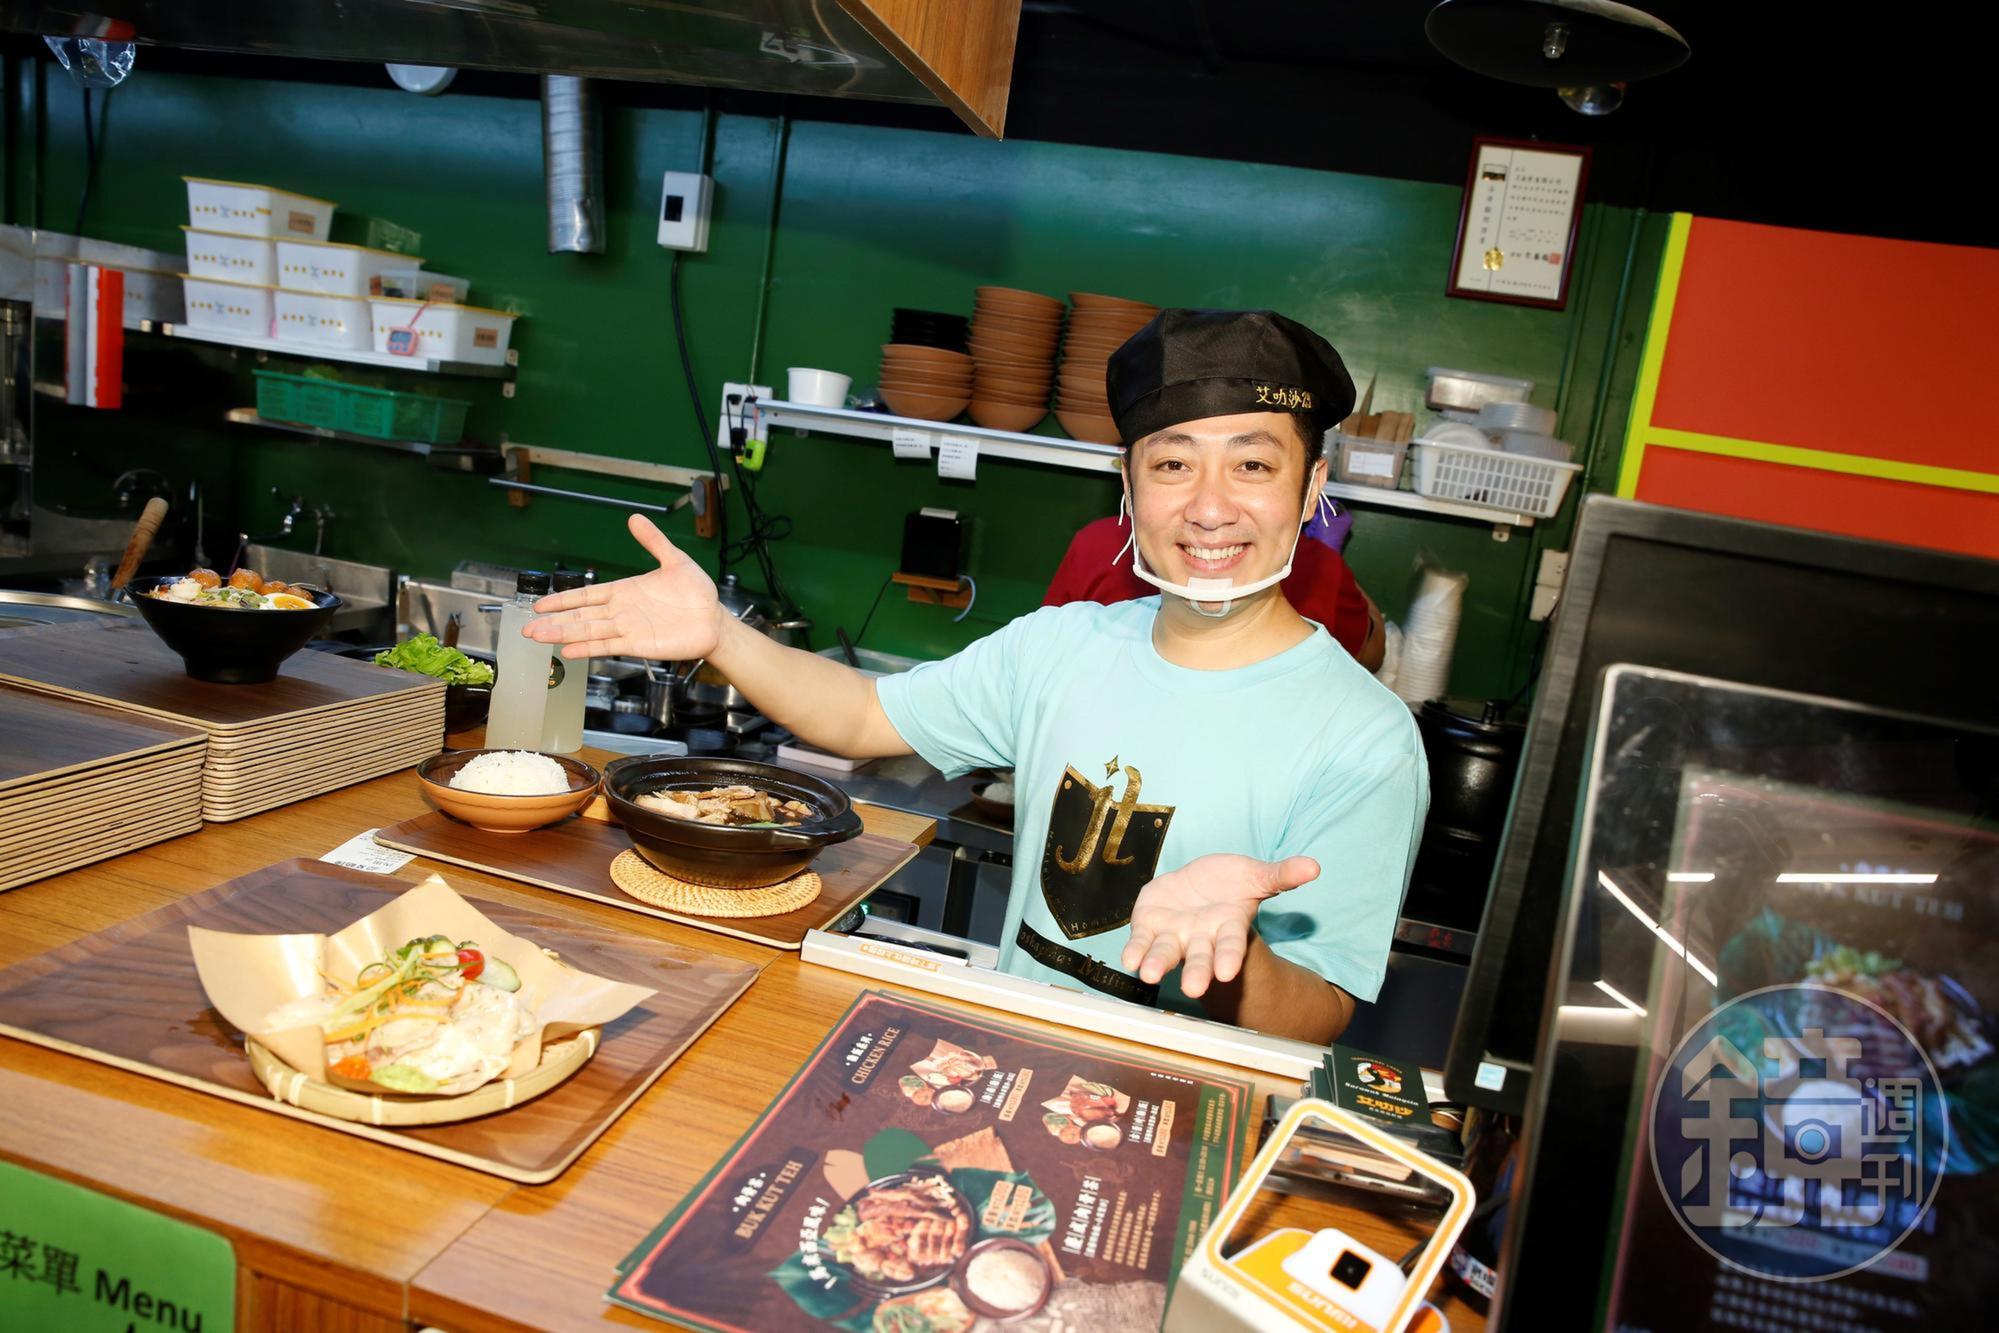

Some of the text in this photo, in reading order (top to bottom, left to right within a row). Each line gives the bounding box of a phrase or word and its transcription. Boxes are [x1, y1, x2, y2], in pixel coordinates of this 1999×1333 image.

[851, 1026, 900, 1084] CHICKEN RICE
[735, 1160, 803, 1239] BUK KUT TEH
[0, 1230, 202, 1333] 菜單 Menu
